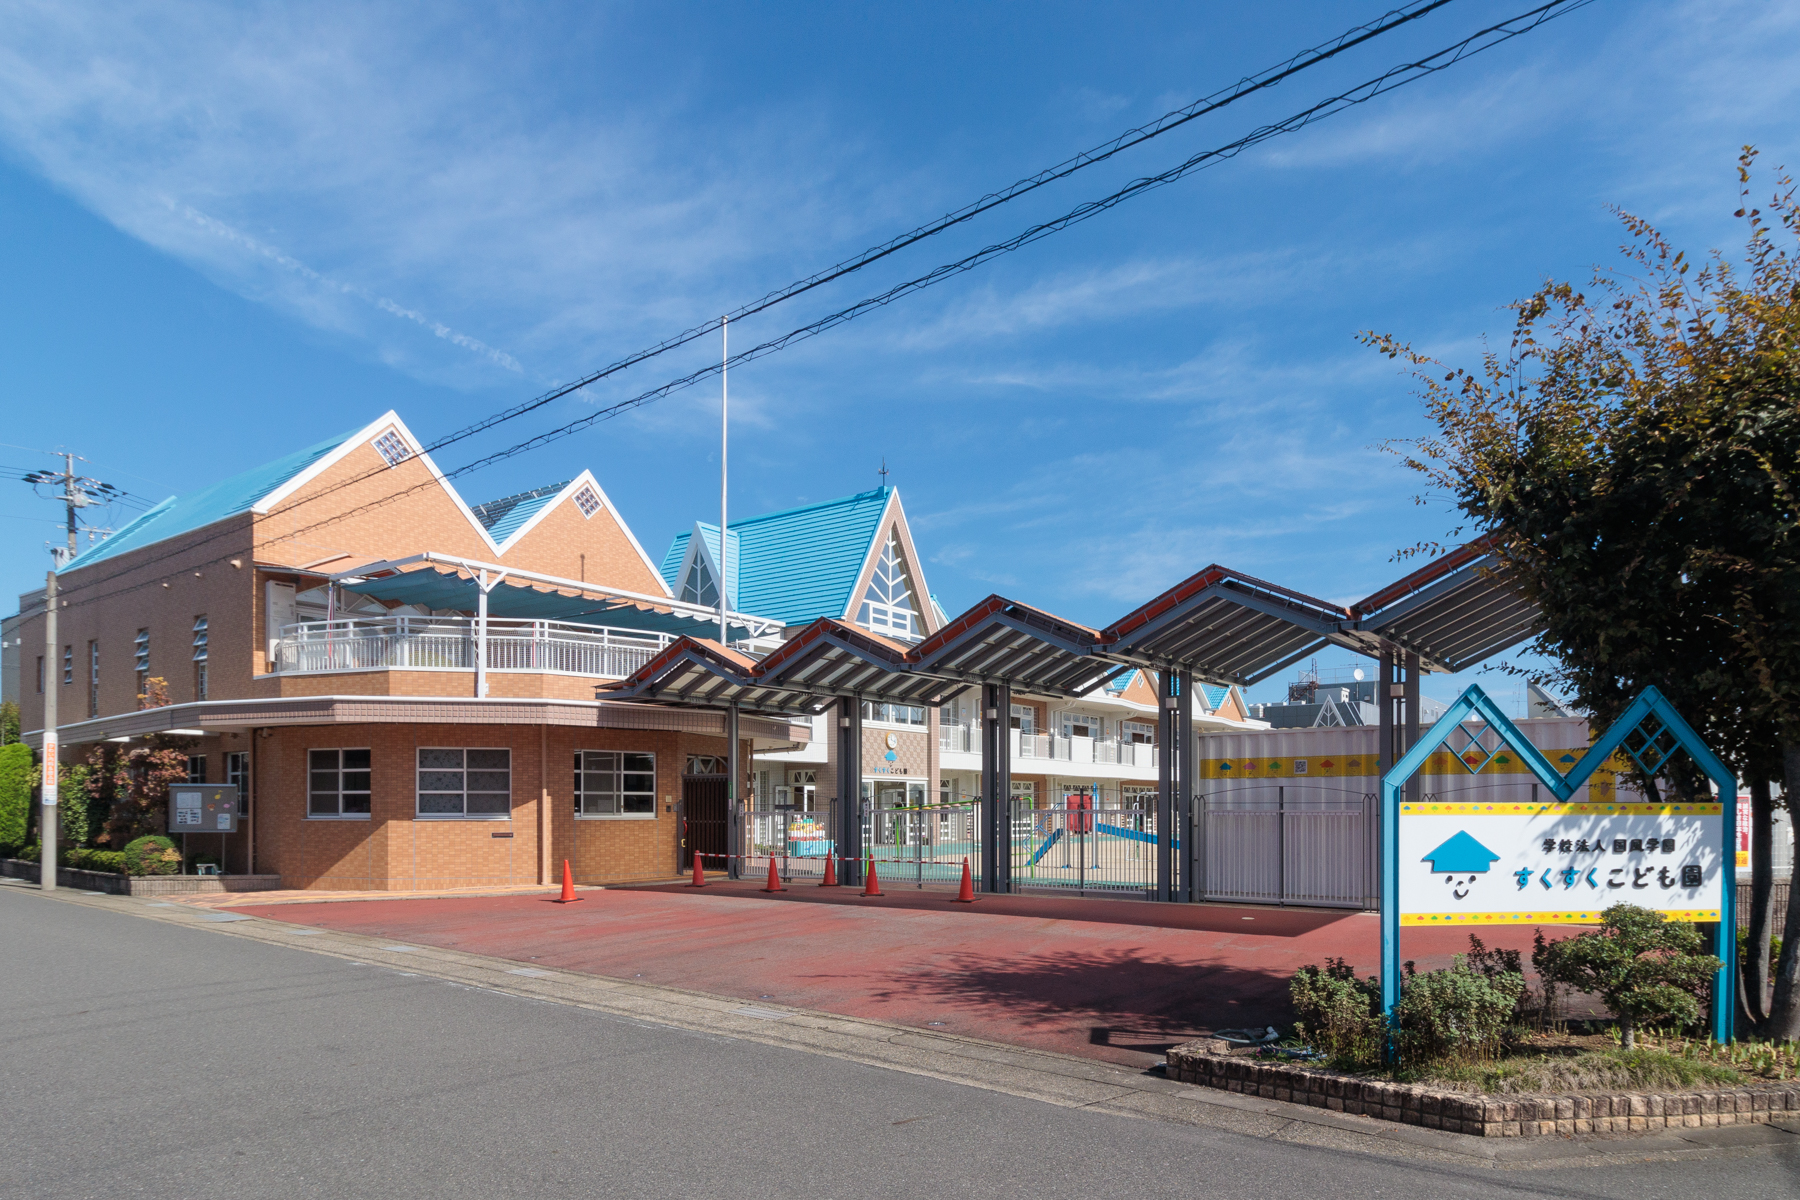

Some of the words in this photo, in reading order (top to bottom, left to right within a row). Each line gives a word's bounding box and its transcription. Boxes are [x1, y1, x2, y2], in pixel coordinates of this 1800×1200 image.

[1514, 865, 1702, 890] すくすくこども園
